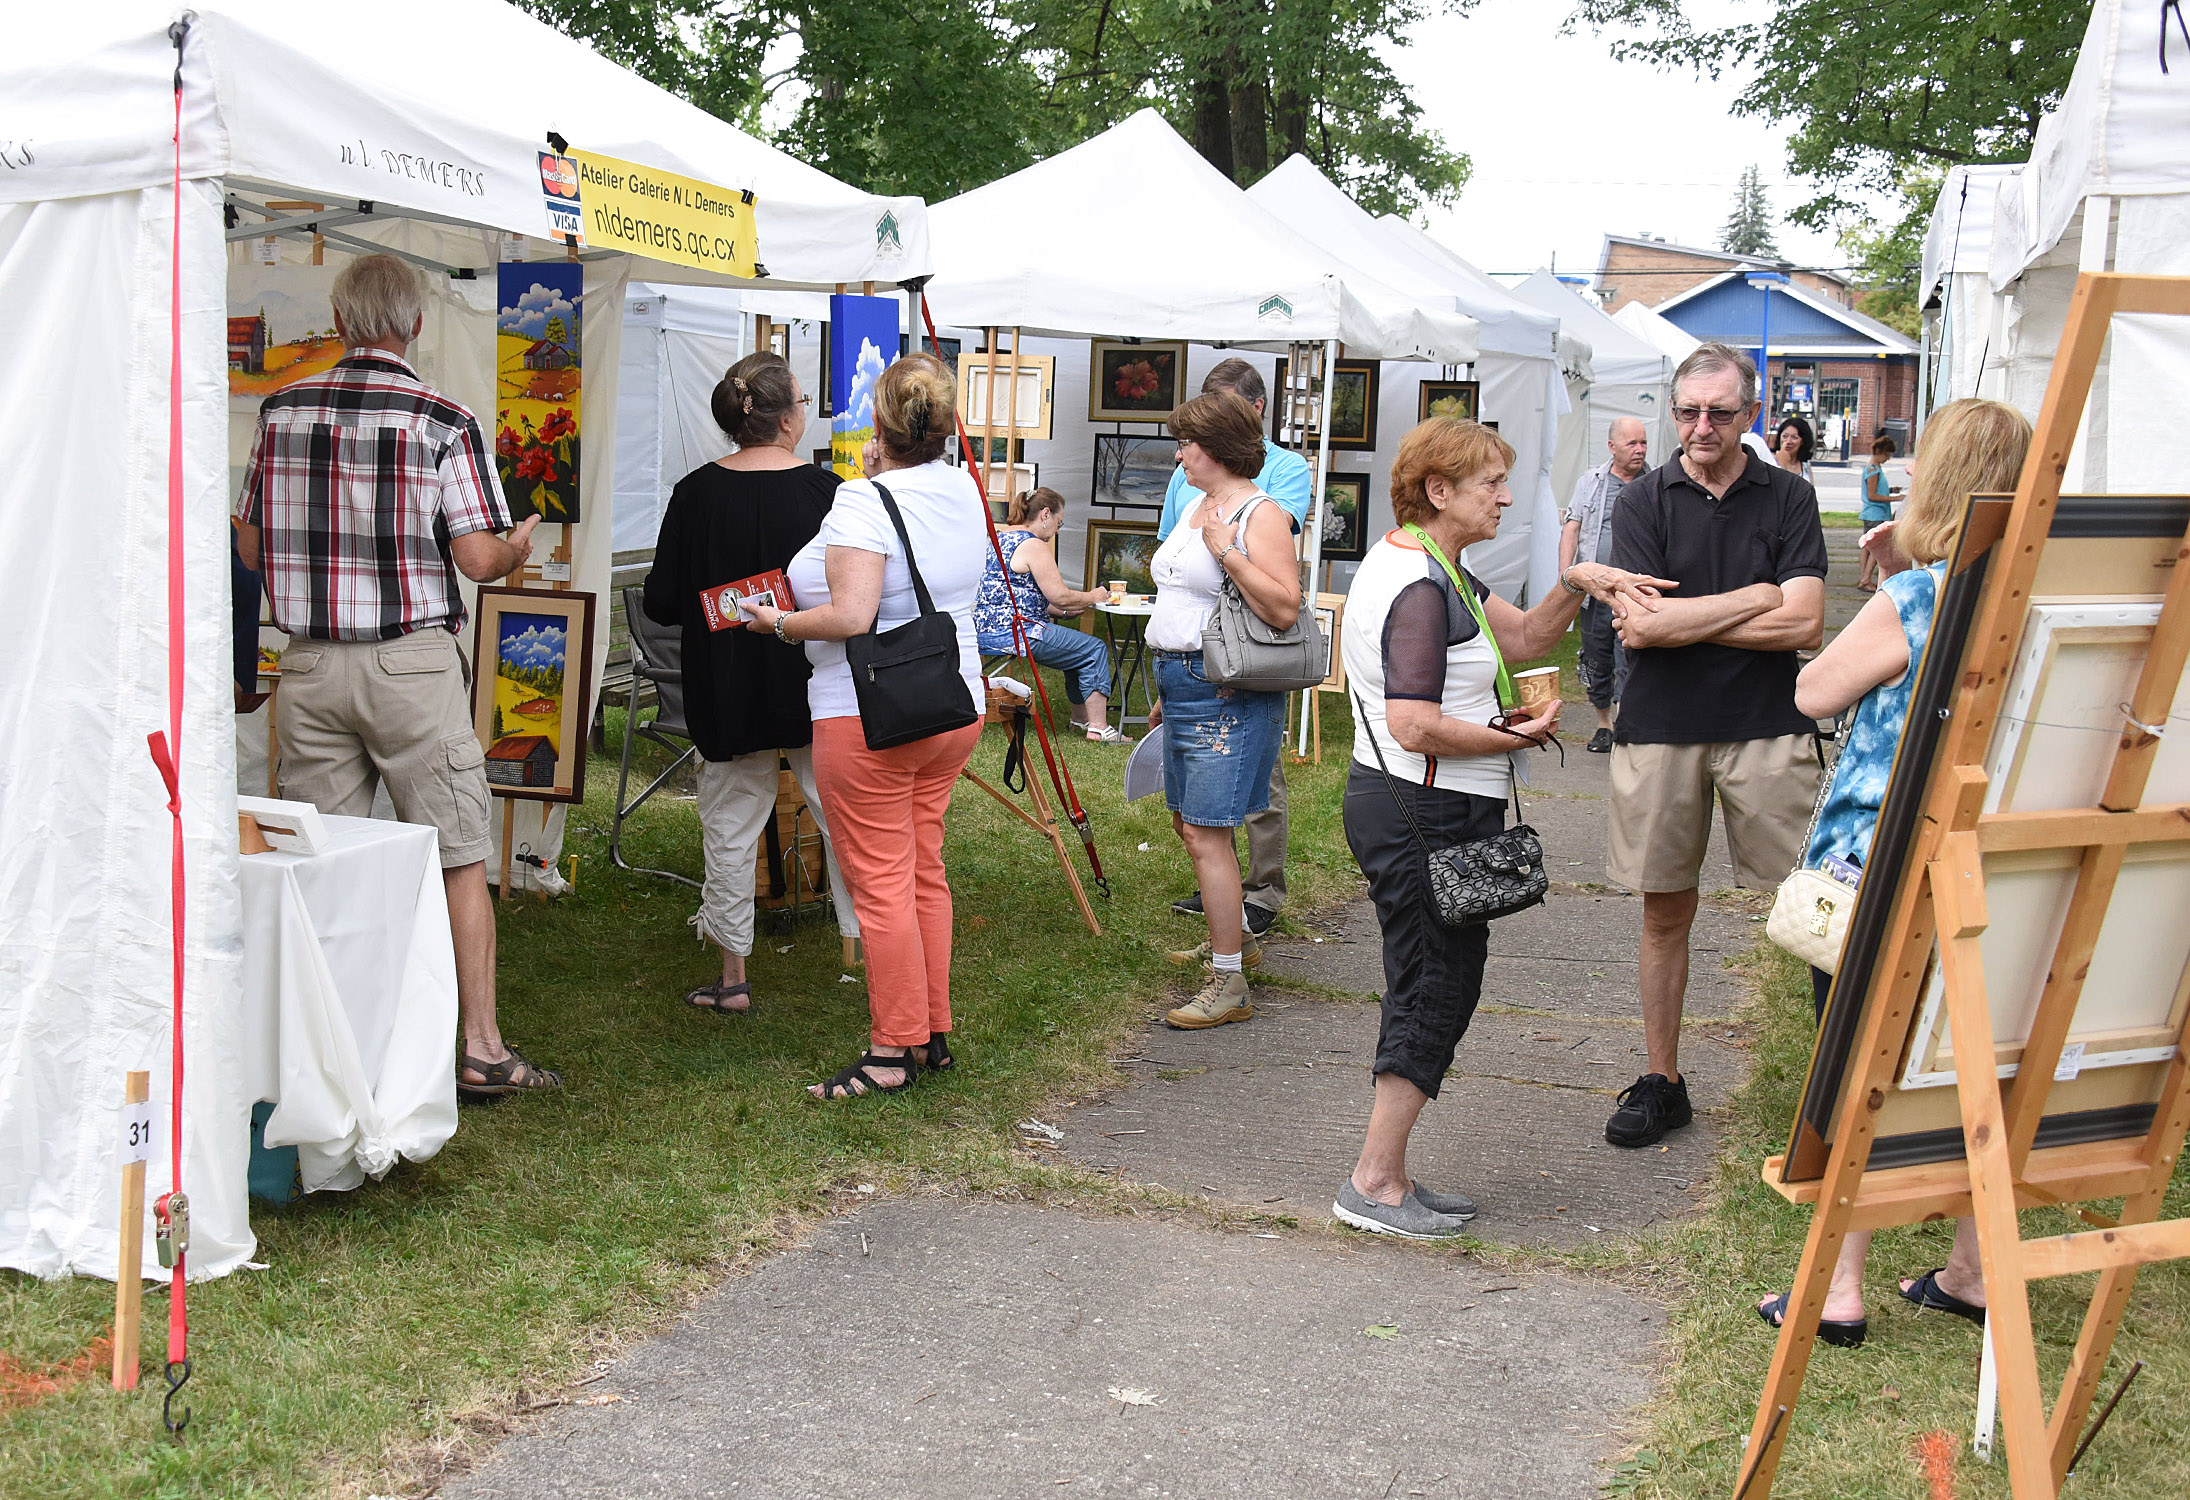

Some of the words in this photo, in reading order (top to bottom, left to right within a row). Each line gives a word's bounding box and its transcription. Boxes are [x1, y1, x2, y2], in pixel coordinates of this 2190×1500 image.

[381, 149, 485, 197] DEMERS
[581, 162, 624, 191] Atelier
[628, 174, 670, 201] Galerie
[673, 185, 682, 205] N
[685, 188, 692, 208] L
[695, 191, 735, 219] Demers
[553, 212, 578, 232] VISA
[594, 203, 736, 263] nldemers.qc.cx
[1259, 297, 1293, 317] CARAVAN
[702, 592, 718, 630] SYMPOSIUM
[129, 1119, 150, 1147] 31
